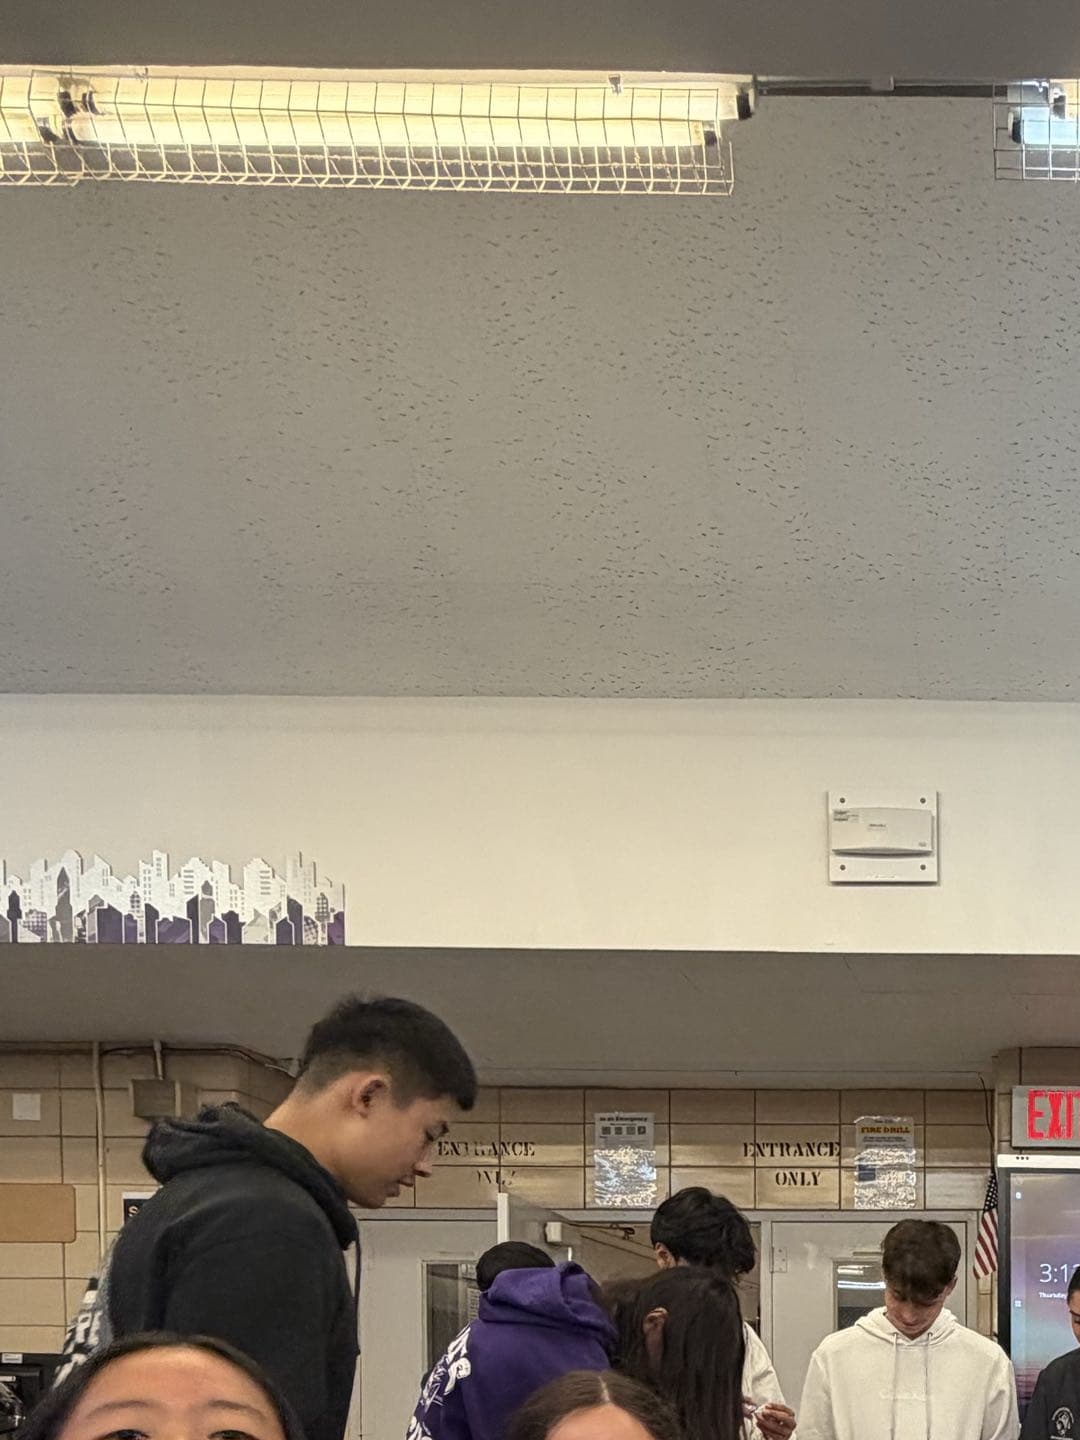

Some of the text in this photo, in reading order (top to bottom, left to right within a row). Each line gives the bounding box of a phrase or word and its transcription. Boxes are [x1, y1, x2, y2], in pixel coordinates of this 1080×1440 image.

[743, 1142, 841, 1158] ENTRANCE
[775, 1171, 821, 1186] ONLY
[1039, 1263, 1080, 1283] 3:1
